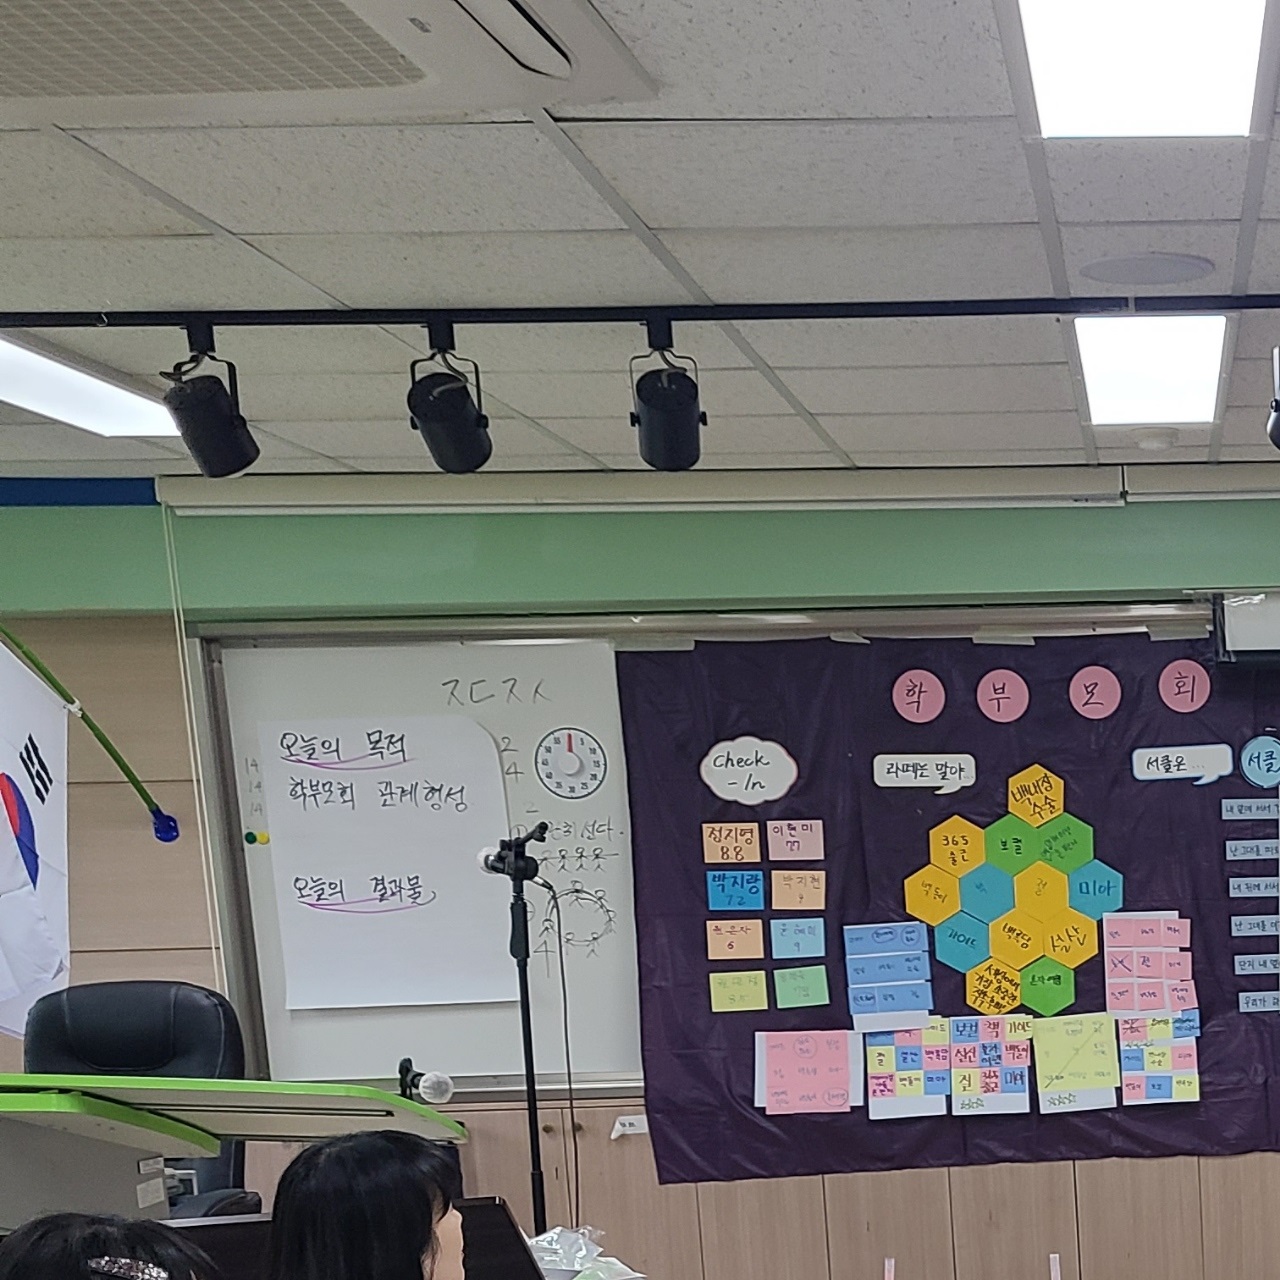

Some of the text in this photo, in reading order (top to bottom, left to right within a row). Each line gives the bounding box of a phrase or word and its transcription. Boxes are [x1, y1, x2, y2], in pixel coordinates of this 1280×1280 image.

[904, 678, 928, 713] 학
[987, 682, 1012, 713] 부
[1082, 681, 1105, 708] 모
[1174, 671, 1197, 703] 회
[280, 731, 406, 761] 오늘의 목적
[886, 761, 930, 780] 라떼는
[1146, 755, 1187, 773] 서클은
[288, 777, 356, 810] 학부모회
[1011, 773, 1054, 805] 백내장
[1029, 794, 1061, 820] 수술
[942, 835, 969, 846] 365
[293, 876, 437, 906] 오늘의 결과물
